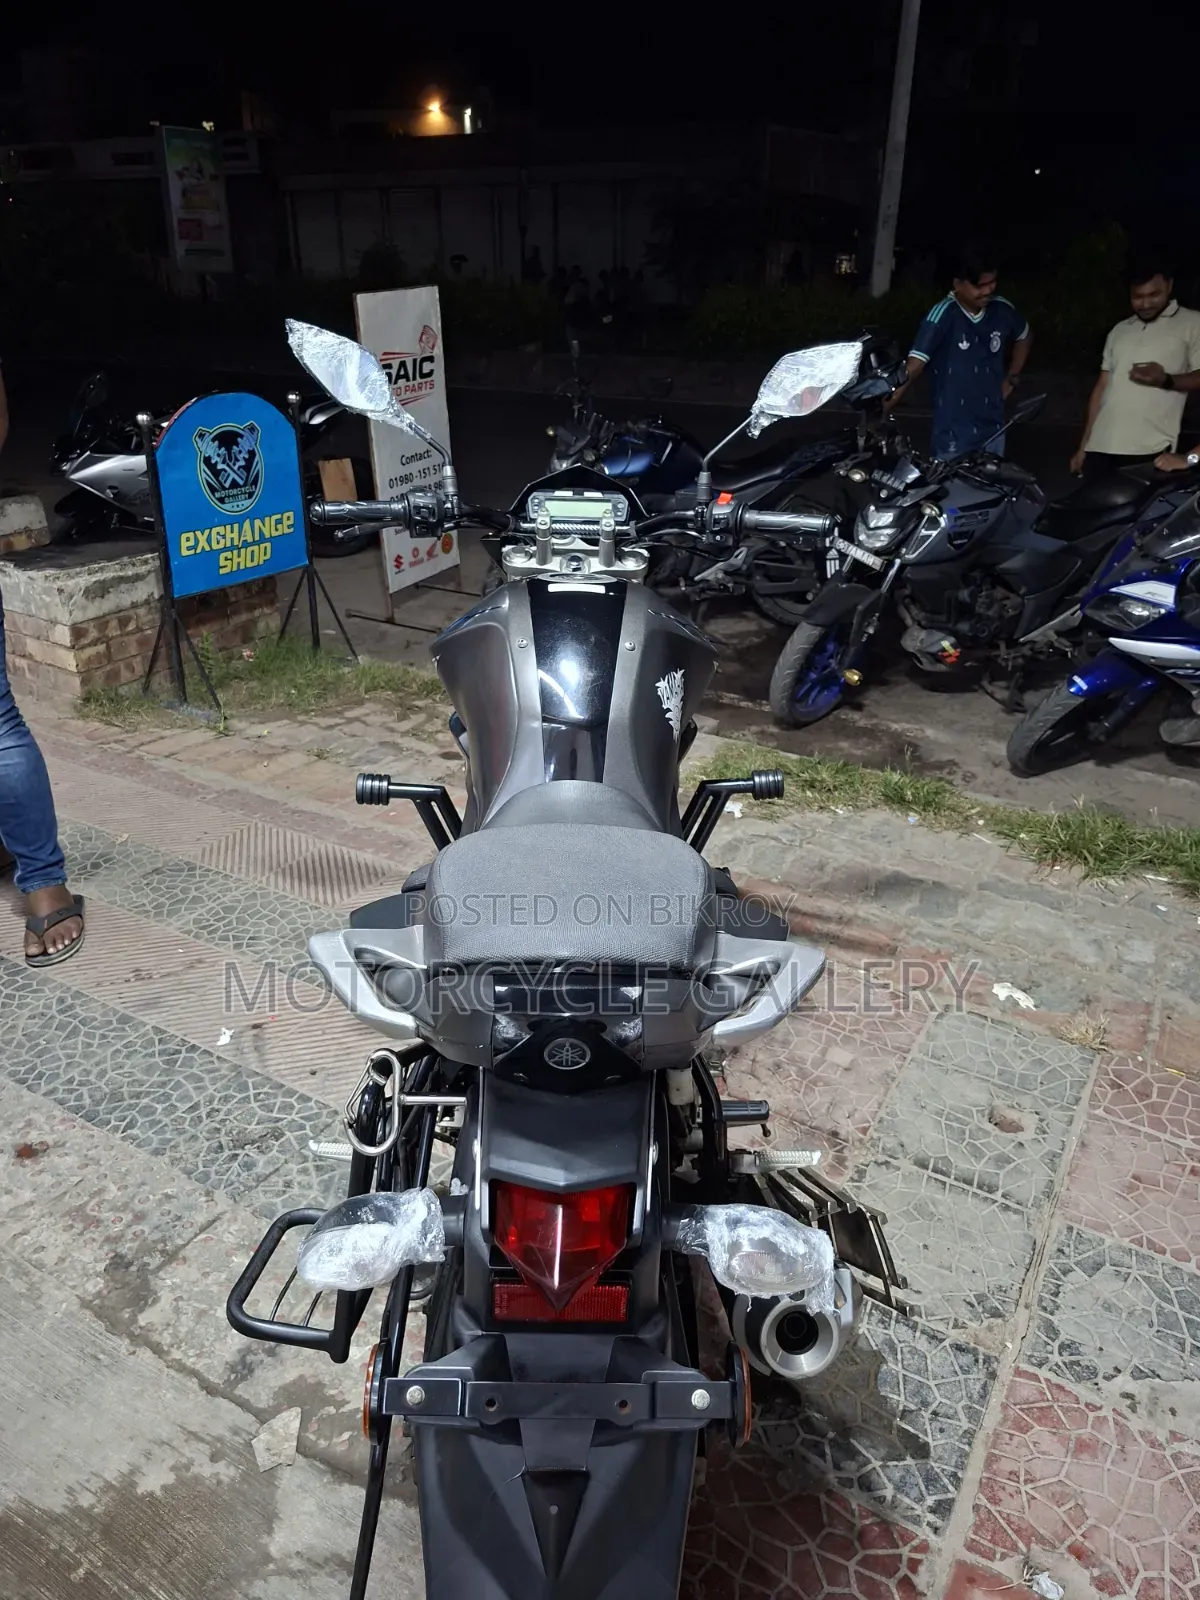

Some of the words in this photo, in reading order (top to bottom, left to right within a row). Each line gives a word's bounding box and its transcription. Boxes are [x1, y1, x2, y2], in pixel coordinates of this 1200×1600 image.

[404, 380, 435, 396] PARTS
[400, 448, 432, 466] Contact:
[214, 484, 256, 499] MOTORCYCLE
[224, 494, 250, 505] GALLERY
[219, 542, 272, 575] SHOP
